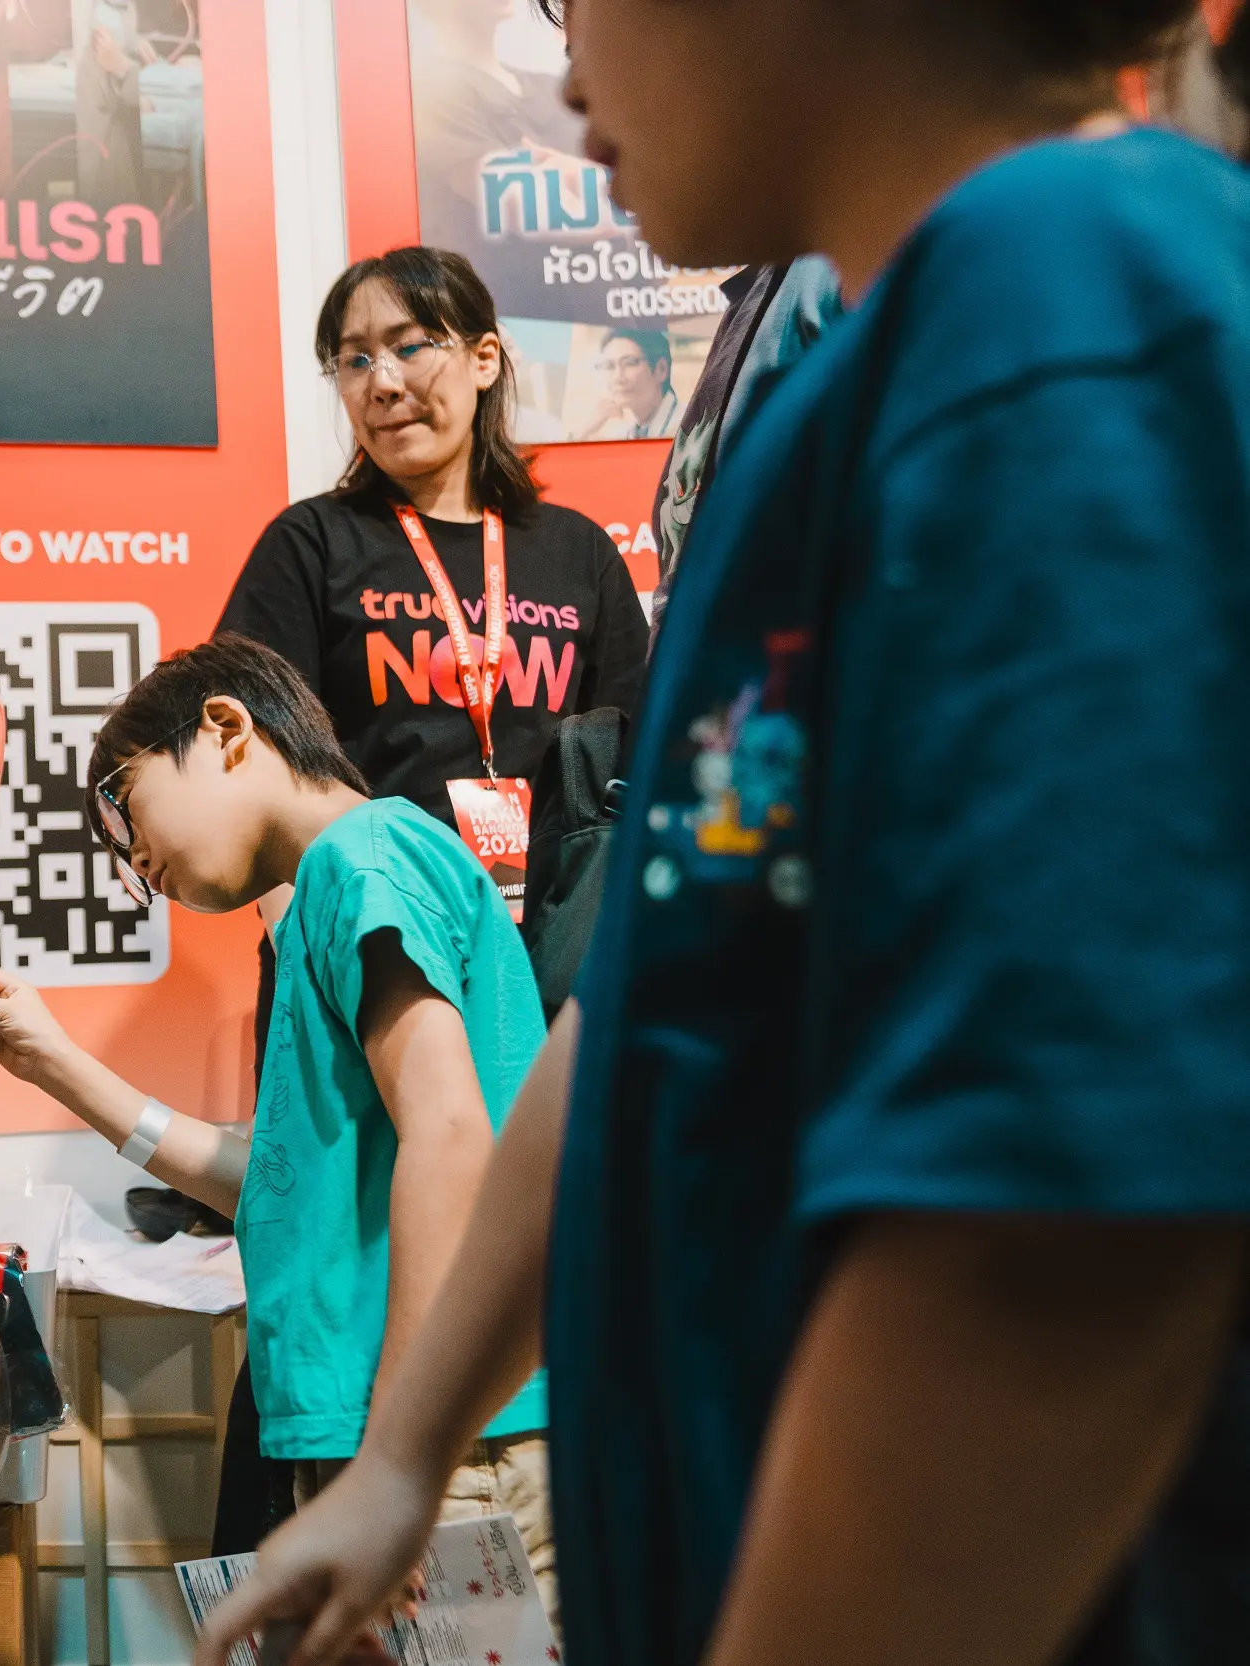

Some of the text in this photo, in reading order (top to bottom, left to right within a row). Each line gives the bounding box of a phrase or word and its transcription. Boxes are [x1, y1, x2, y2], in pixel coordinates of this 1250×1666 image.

[482, 150, 636, 234] ทีม
[39, 531, 189, 564] WATCH
[488, 564, 502, 618] BANGKOK
[366, 629, 576, 713] NOW
[470, 803, 524, 825] HAKU
